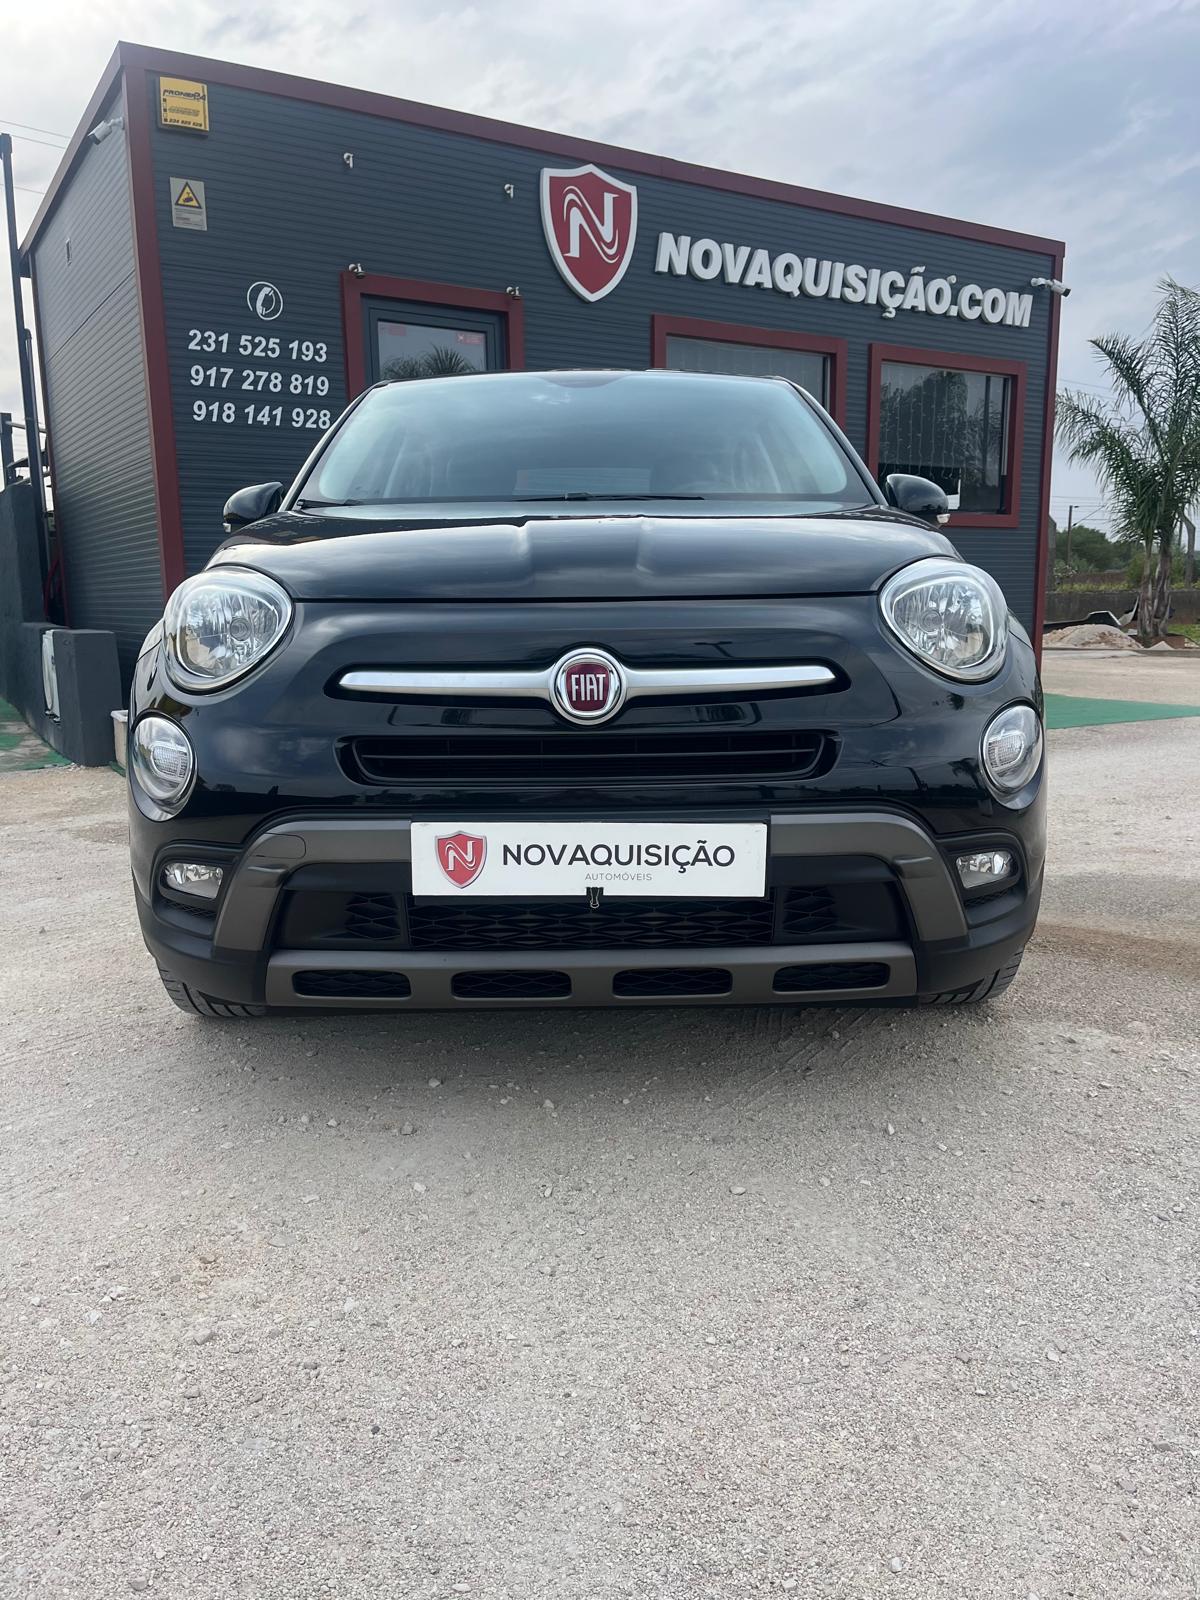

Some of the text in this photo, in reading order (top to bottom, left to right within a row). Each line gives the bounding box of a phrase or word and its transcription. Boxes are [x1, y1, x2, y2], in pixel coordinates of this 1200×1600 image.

[655, 232, 1033, 328] NOVAQUISIÇÃO.COM
[188, 329, 327, 362] 231 525 193
[190, 365, 329, 396] 917 278 819
[193, 400, 331, 429] 918 141 928
[571, 674, 606, 701] FIAT
[502, 840, 735, 873] NOVAQUISIÇÃO
[585, 872, 652, 881] AUTOMÓVEIS
